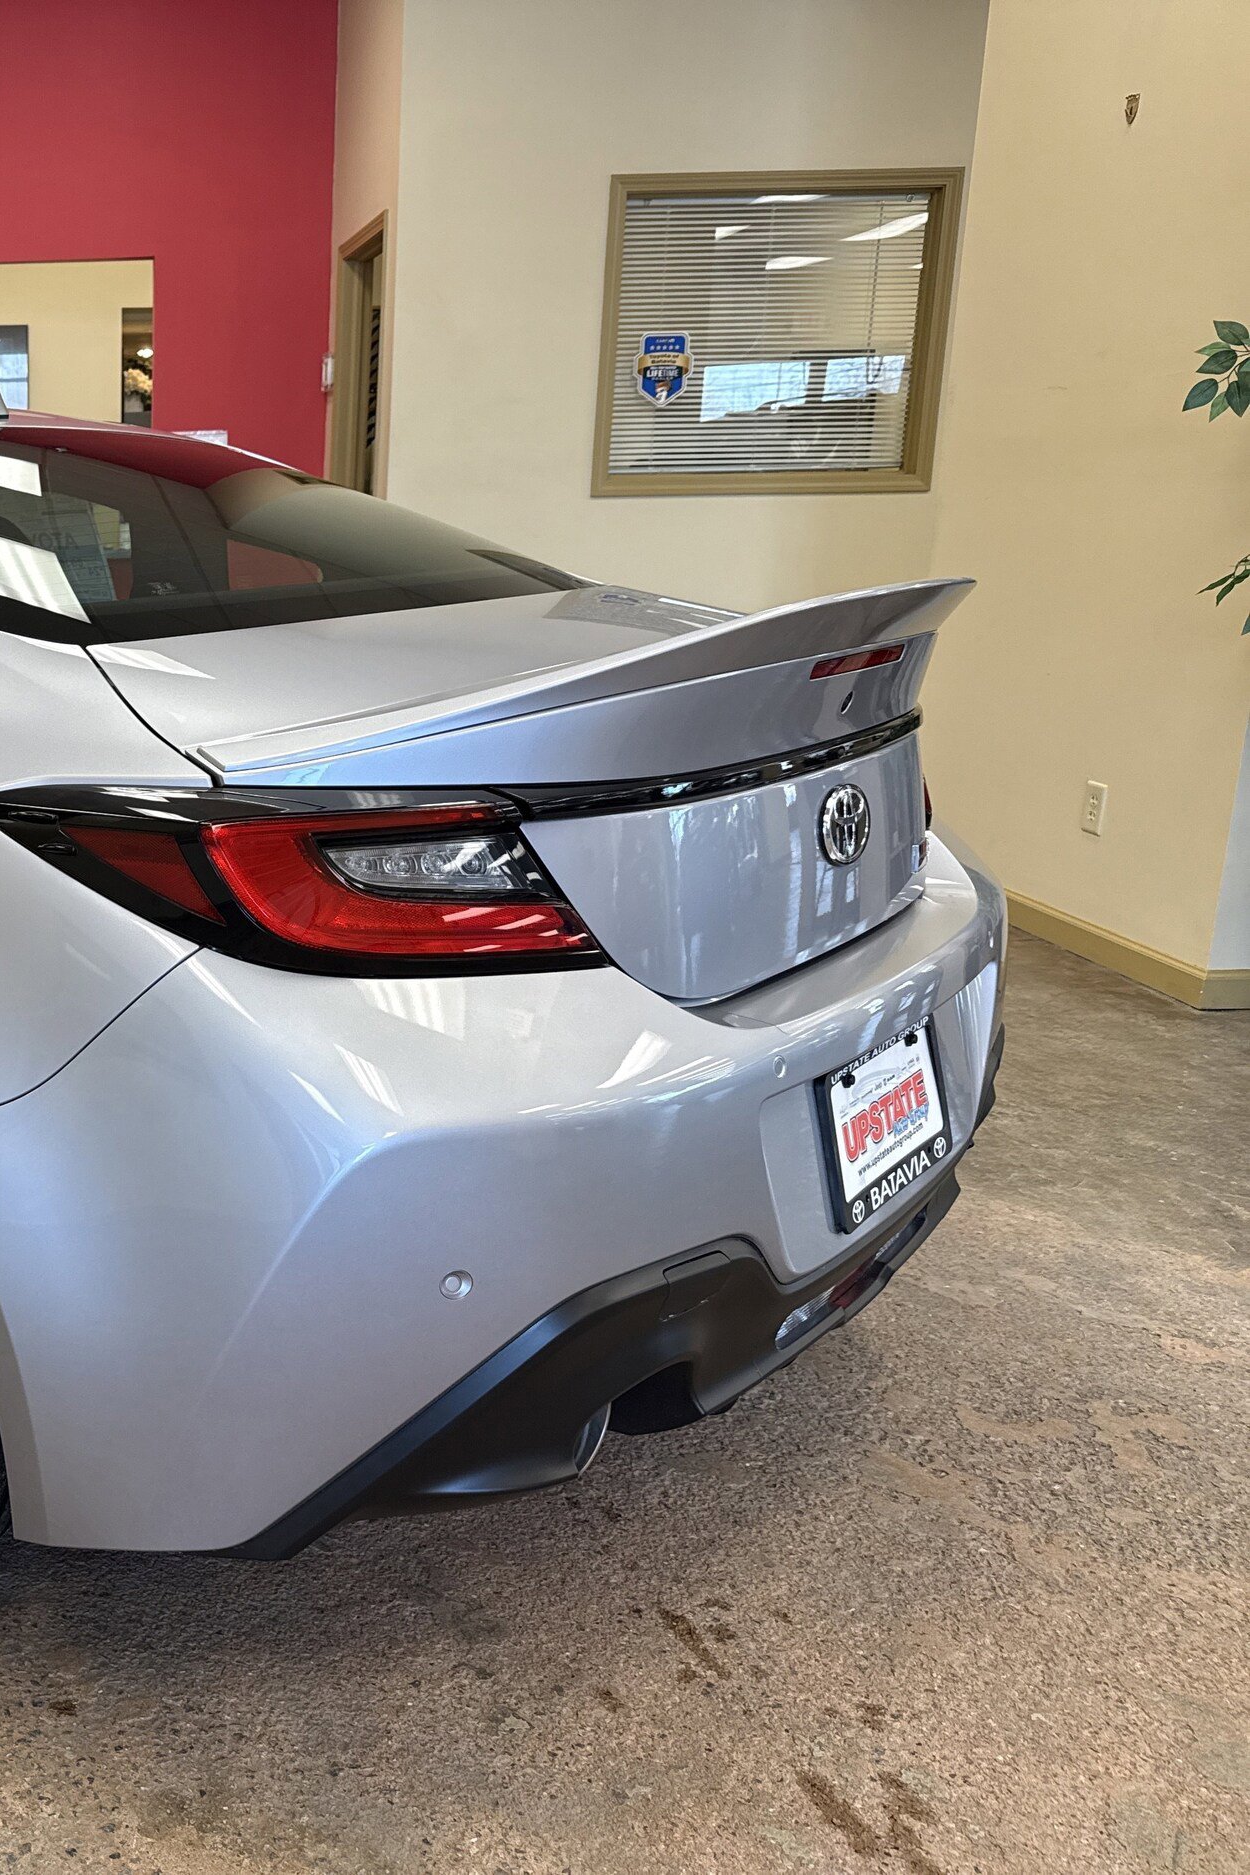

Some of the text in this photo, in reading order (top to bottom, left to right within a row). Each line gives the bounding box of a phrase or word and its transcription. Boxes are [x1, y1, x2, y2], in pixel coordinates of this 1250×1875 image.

[831, 1053, 871, 1085] UPSTATE
[871, 1037, 897, 1058] AUTO
[897, 1016, 929, 1042] GROUP
[842, 1069, 929, 1163] UPSTATE
[858, 1122, 924, 1176] www.upstateautogroup.com
[870, 1150, 931, 1211] BATAVIA
